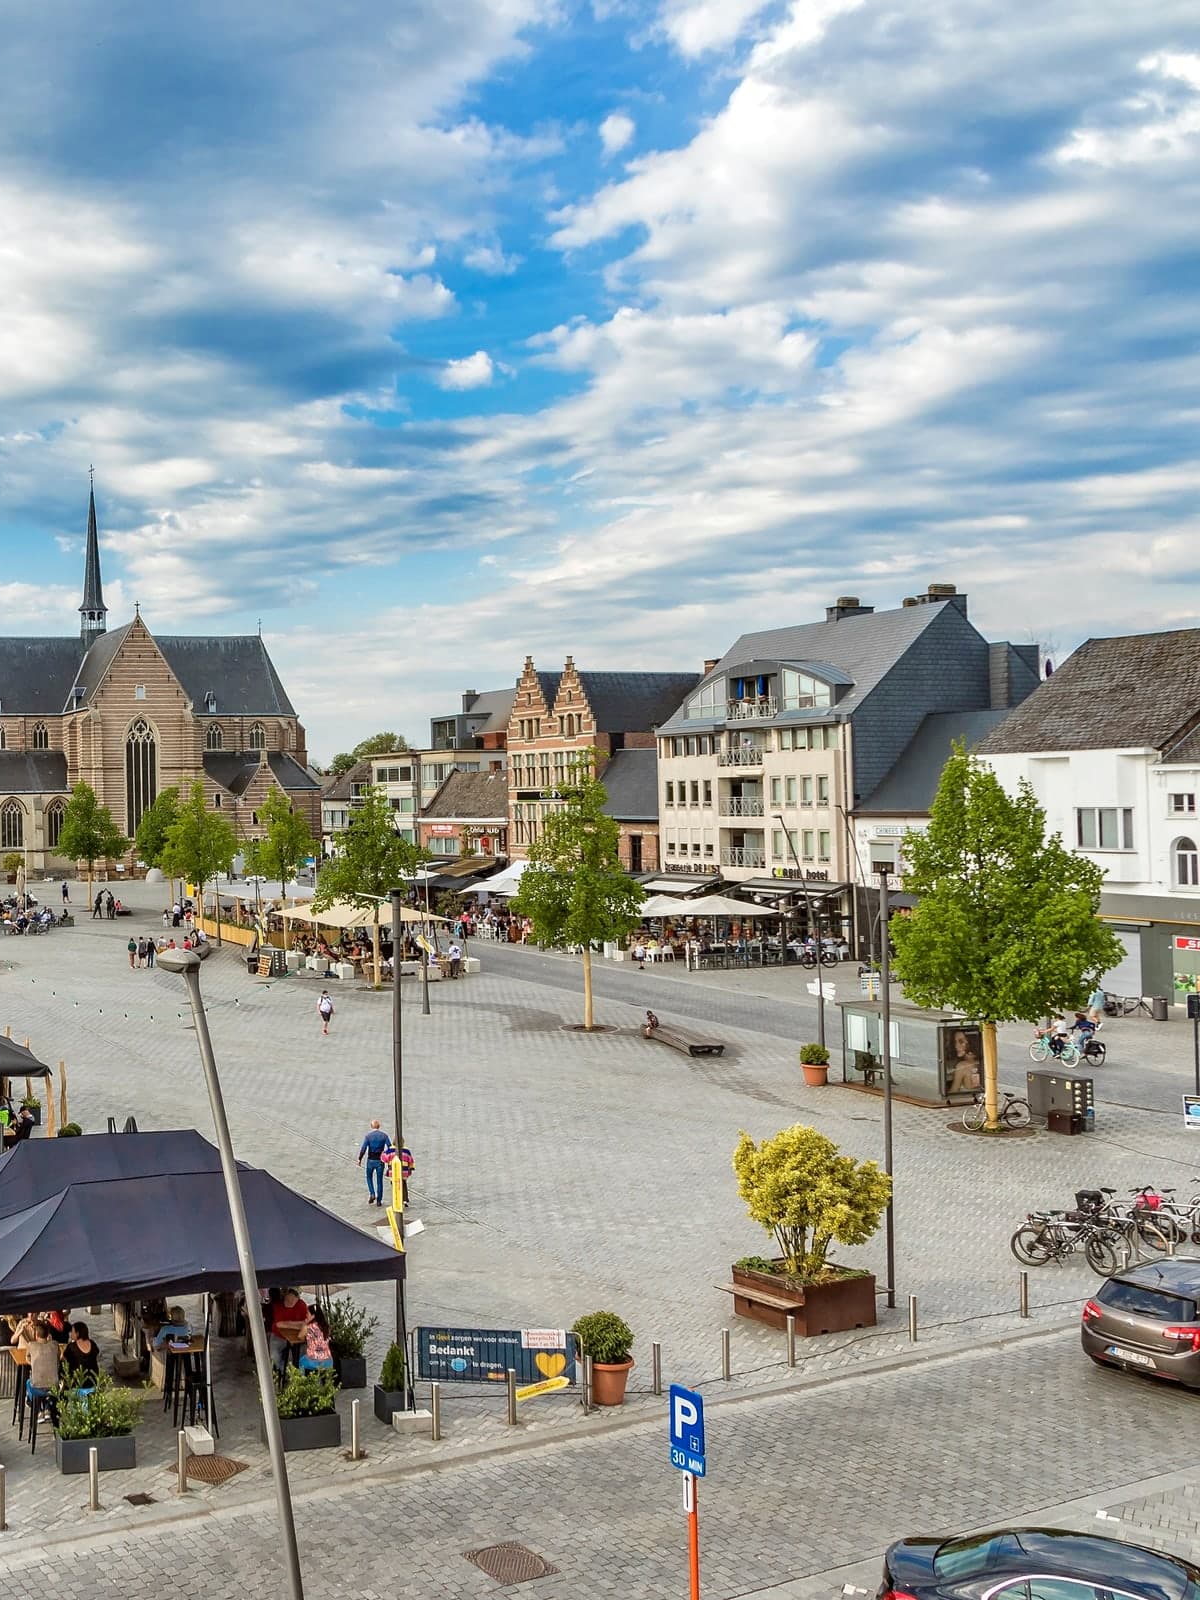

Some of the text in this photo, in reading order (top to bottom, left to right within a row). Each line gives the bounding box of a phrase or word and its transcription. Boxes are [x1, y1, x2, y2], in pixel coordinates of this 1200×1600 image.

[665, 861, 692, 873] brasserie
[694, 863, 703, 872] DE
[806, 868, 828, 880] hotel
[451, 1334, 472, 1342] zorgen
[498, 1336, 519, 1344] elkaar.
[429, 1345, 475, 1356] Bedankt
[439, 1359, 446, 1367] je
[480, 1361, 503, 1369] dragen.
[674, 1395, 698, 1439] P
[672, 1449, 703, 1473] 30 MIN
